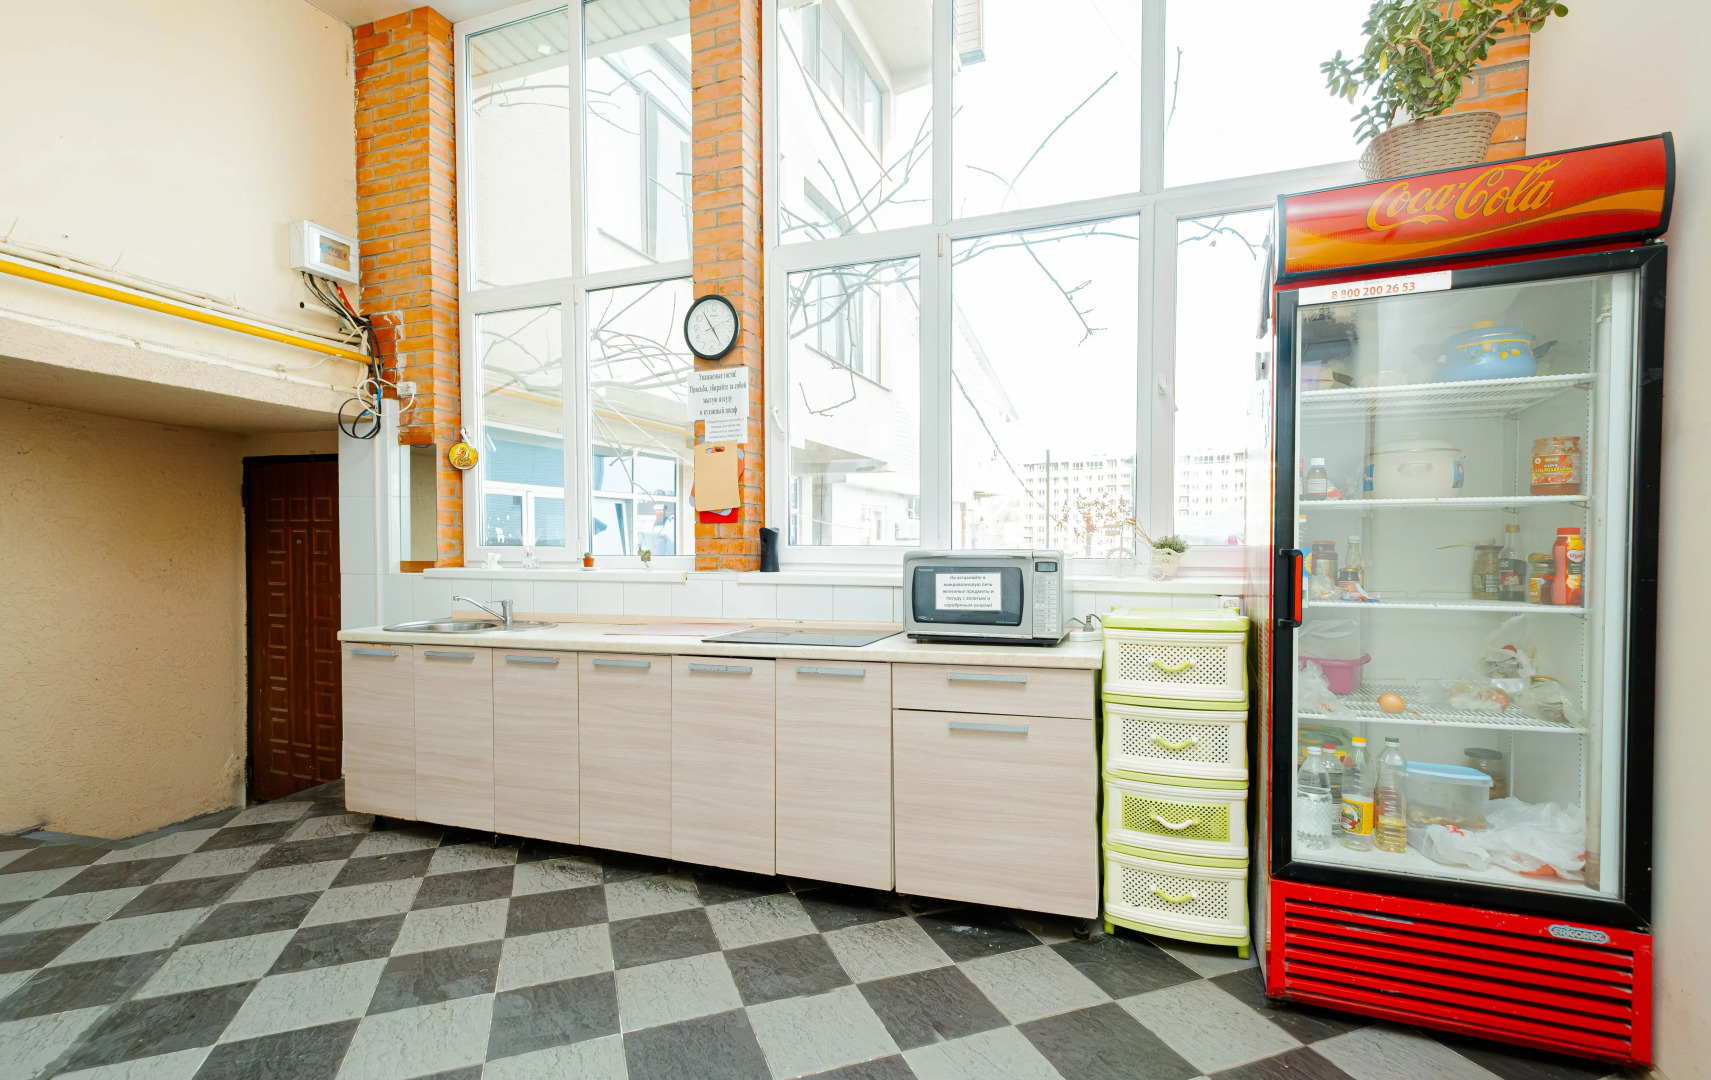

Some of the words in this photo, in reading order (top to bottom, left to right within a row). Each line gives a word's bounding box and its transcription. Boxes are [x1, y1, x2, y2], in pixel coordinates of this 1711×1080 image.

[1366, 156, 1564, 232] Coca-Cola
[1331, 290, 1338, 300] 8
[1340, 288, 1361, 299] 800
[1363, 285, 1383, 296] 200
[1385, 283, 1399, 294] 26
[1402, 281, 1416, 292] 53
[1554, 928, 1602, 940] FRIGOREX
